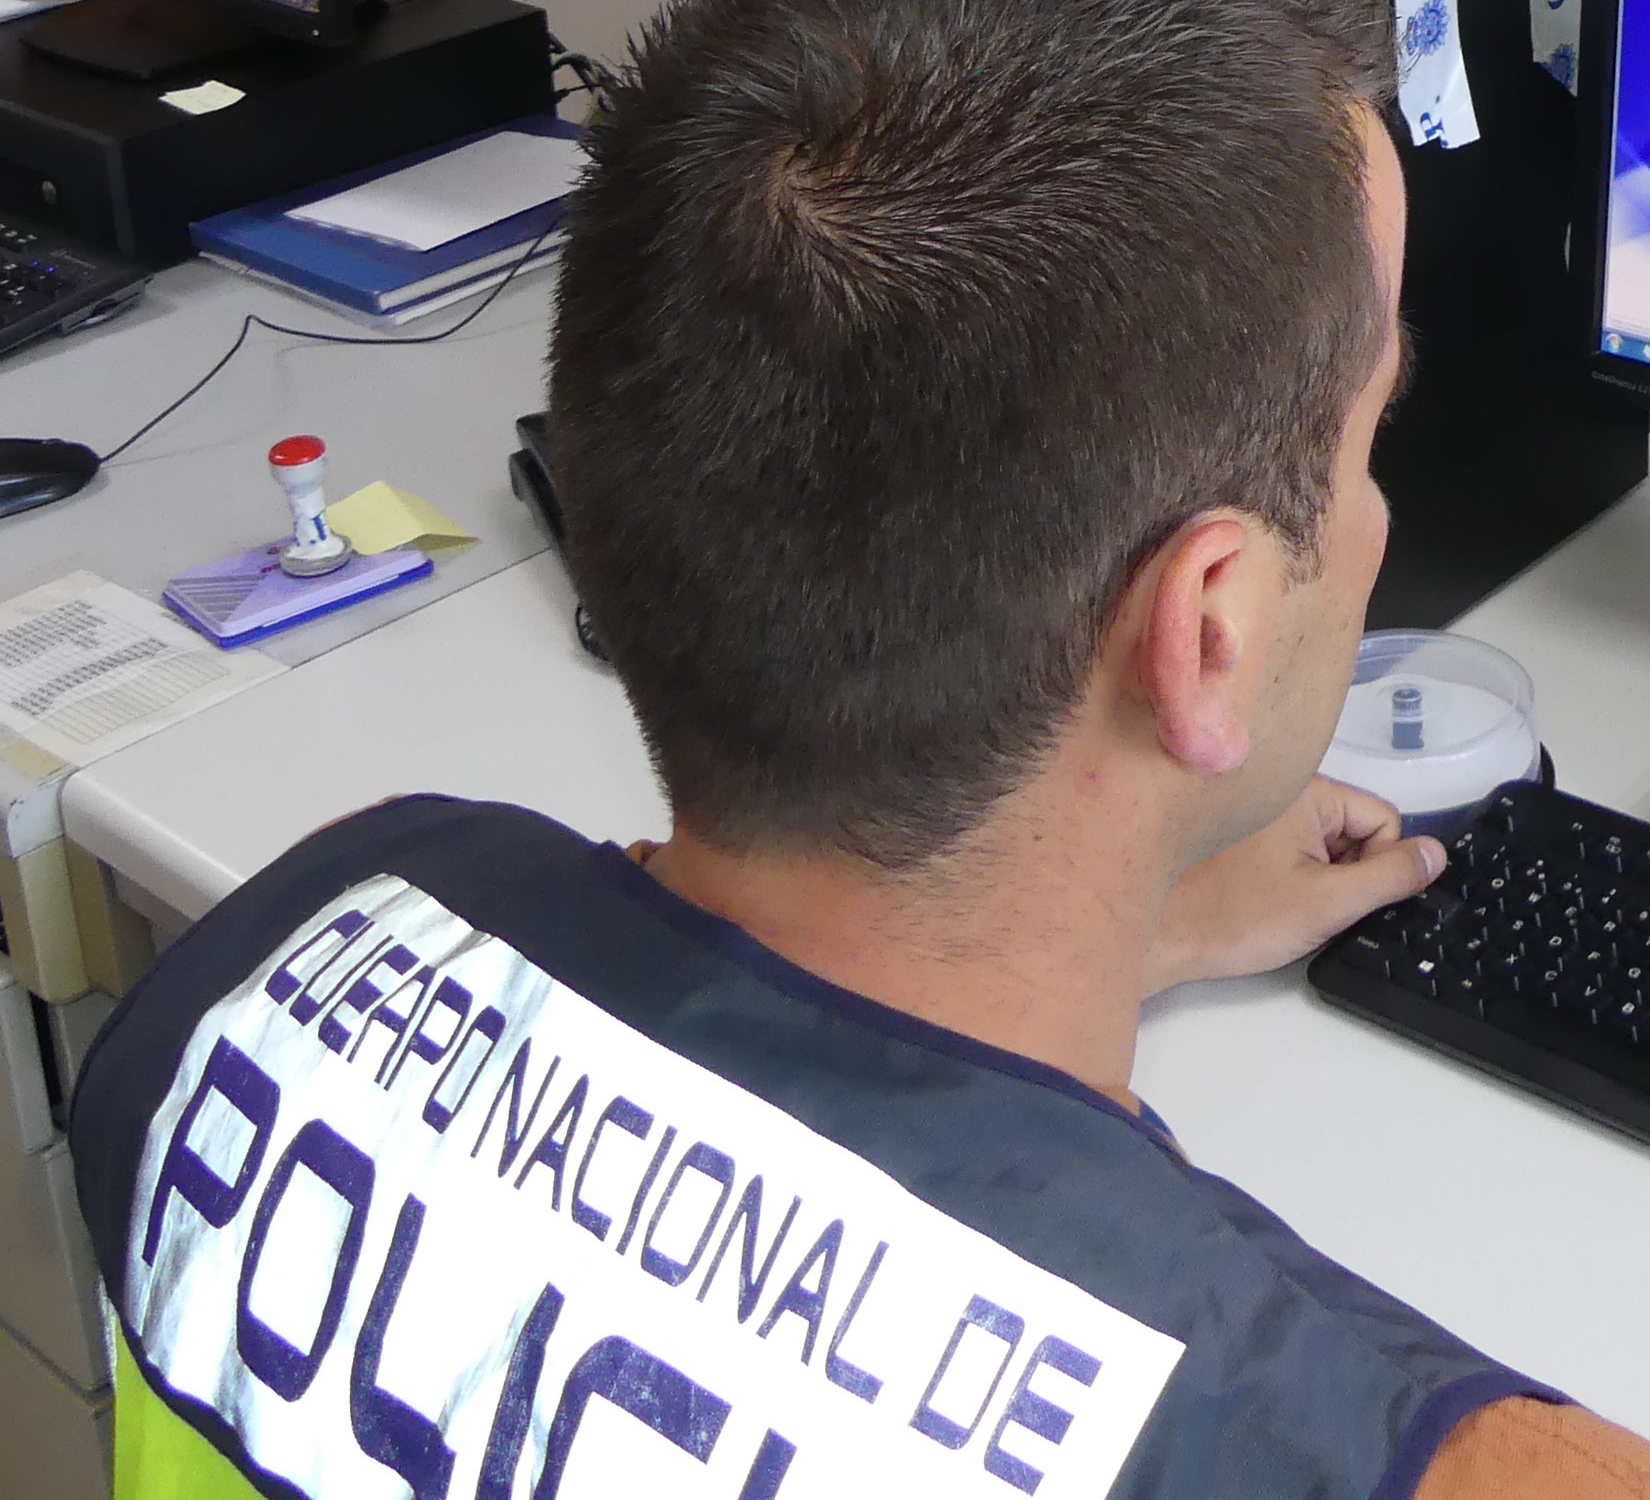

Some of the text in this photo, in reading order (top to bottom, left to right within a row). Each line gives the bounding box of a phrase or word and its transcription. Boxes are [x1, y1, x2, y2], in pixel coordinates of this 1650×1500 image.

[265, 908, 1103, 1497] CUERPO NACIONAL DE
